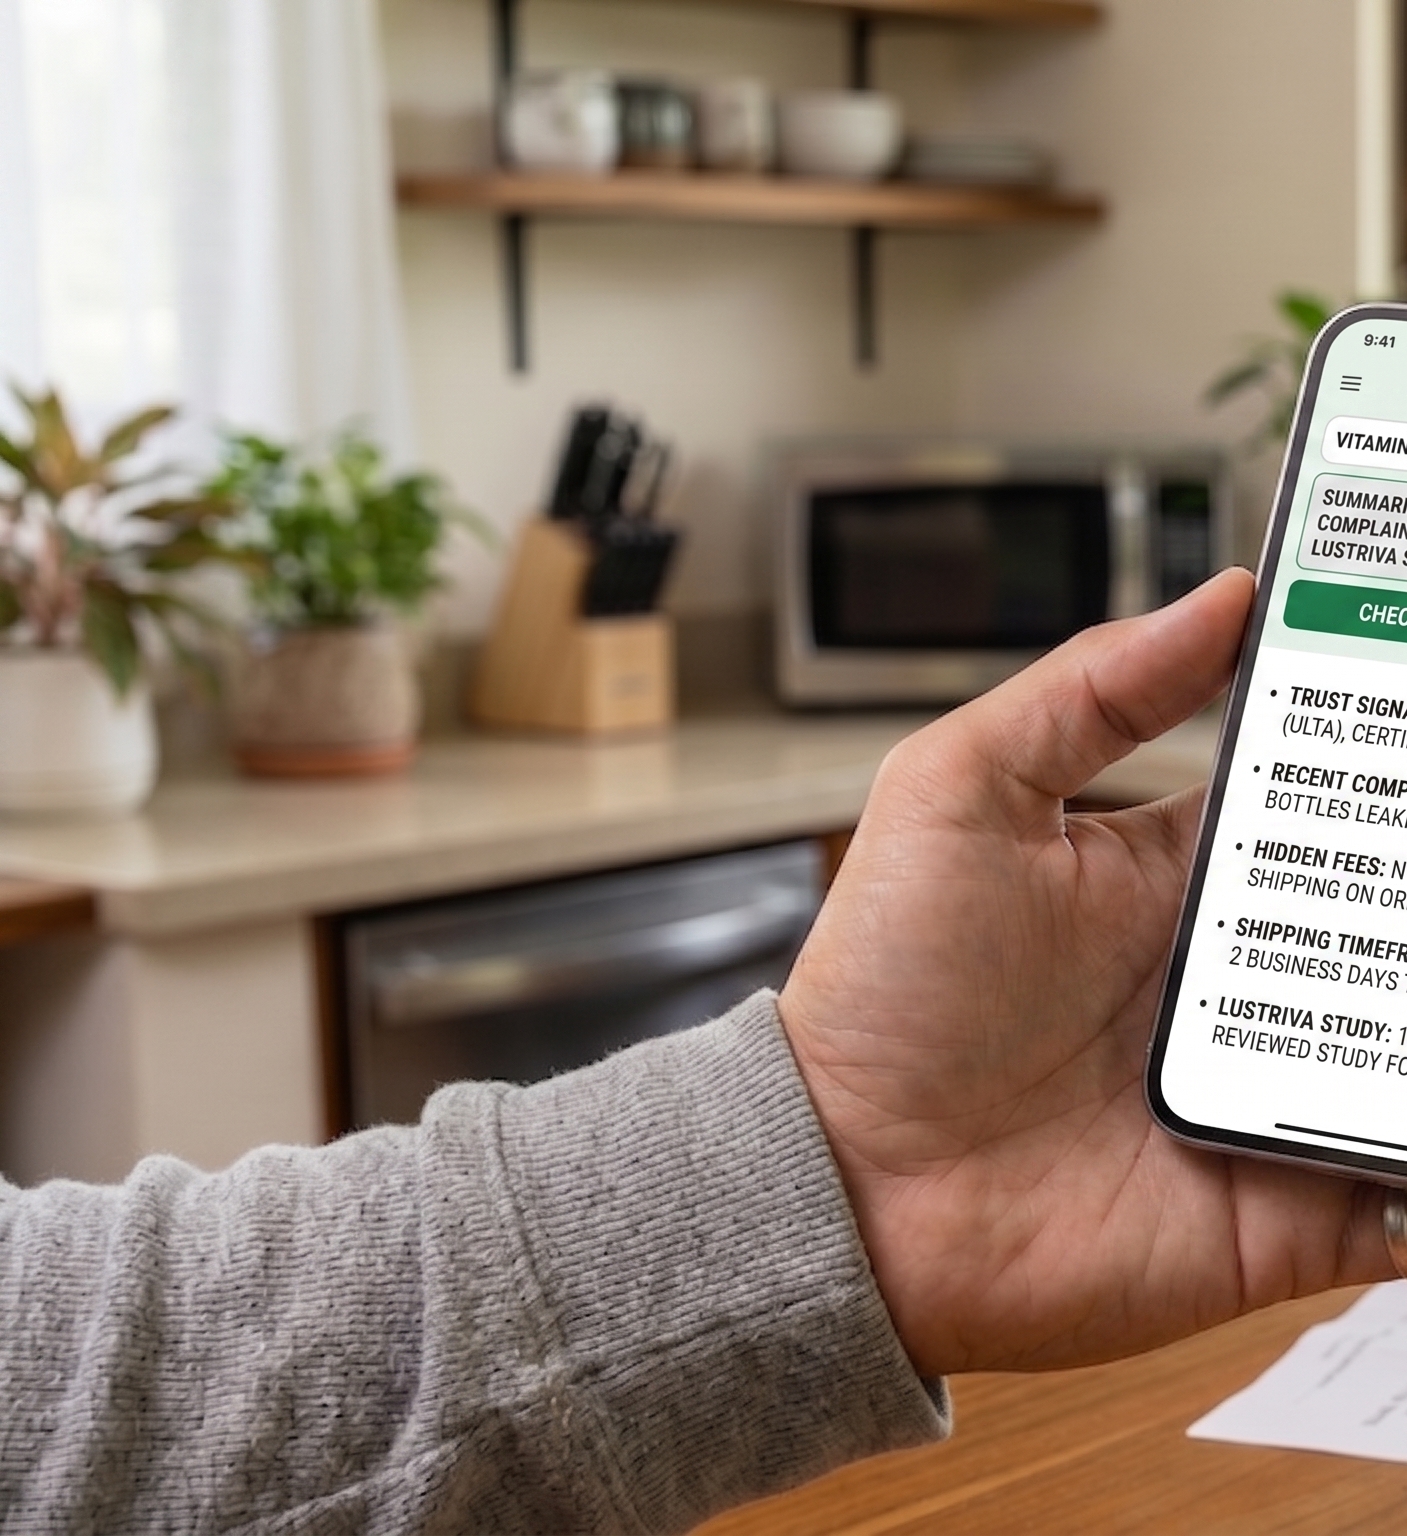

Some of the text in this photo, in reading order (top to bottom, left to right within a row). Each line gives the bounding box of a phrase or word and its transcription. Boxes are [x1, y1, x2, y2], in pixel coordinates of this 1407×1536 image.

[1363, 333, 1396, 349] 9:41
[1310, 538, 1397, 565] LUSTRIVA
[1290, 685, 1354, 712] TRUST
[1282, 712, 1345, 745] (ULTA),
[1270, 761, 1349, 790] RECENT
[1264, 789, 1352, 820] BOTTLES
[1253, 839, 1329, 869] HIDDEN
[1331, 851, 1387, 877] FEES:
[1247, 867, 1341, 900] SHIPPING
[1345, 882, 1375, 905] ON
[1235, 917, 1332, 950] SHIPPING
[1228, 945, 1242, 966] 2
[1246, 948, 1343, 982] BUSINESS
[1347, 964, 1400, 991] DAYS
[1217, 996, 1314, 1031] LUSTRIVA
[1320, 1013, 1392, 1043] STUDY:
[1399, 1026, 1407, 1046] 1
[1211, 1024, 1311, 1059] REVIEWED
[1316, 1042, 1383, 1071] STUDY
